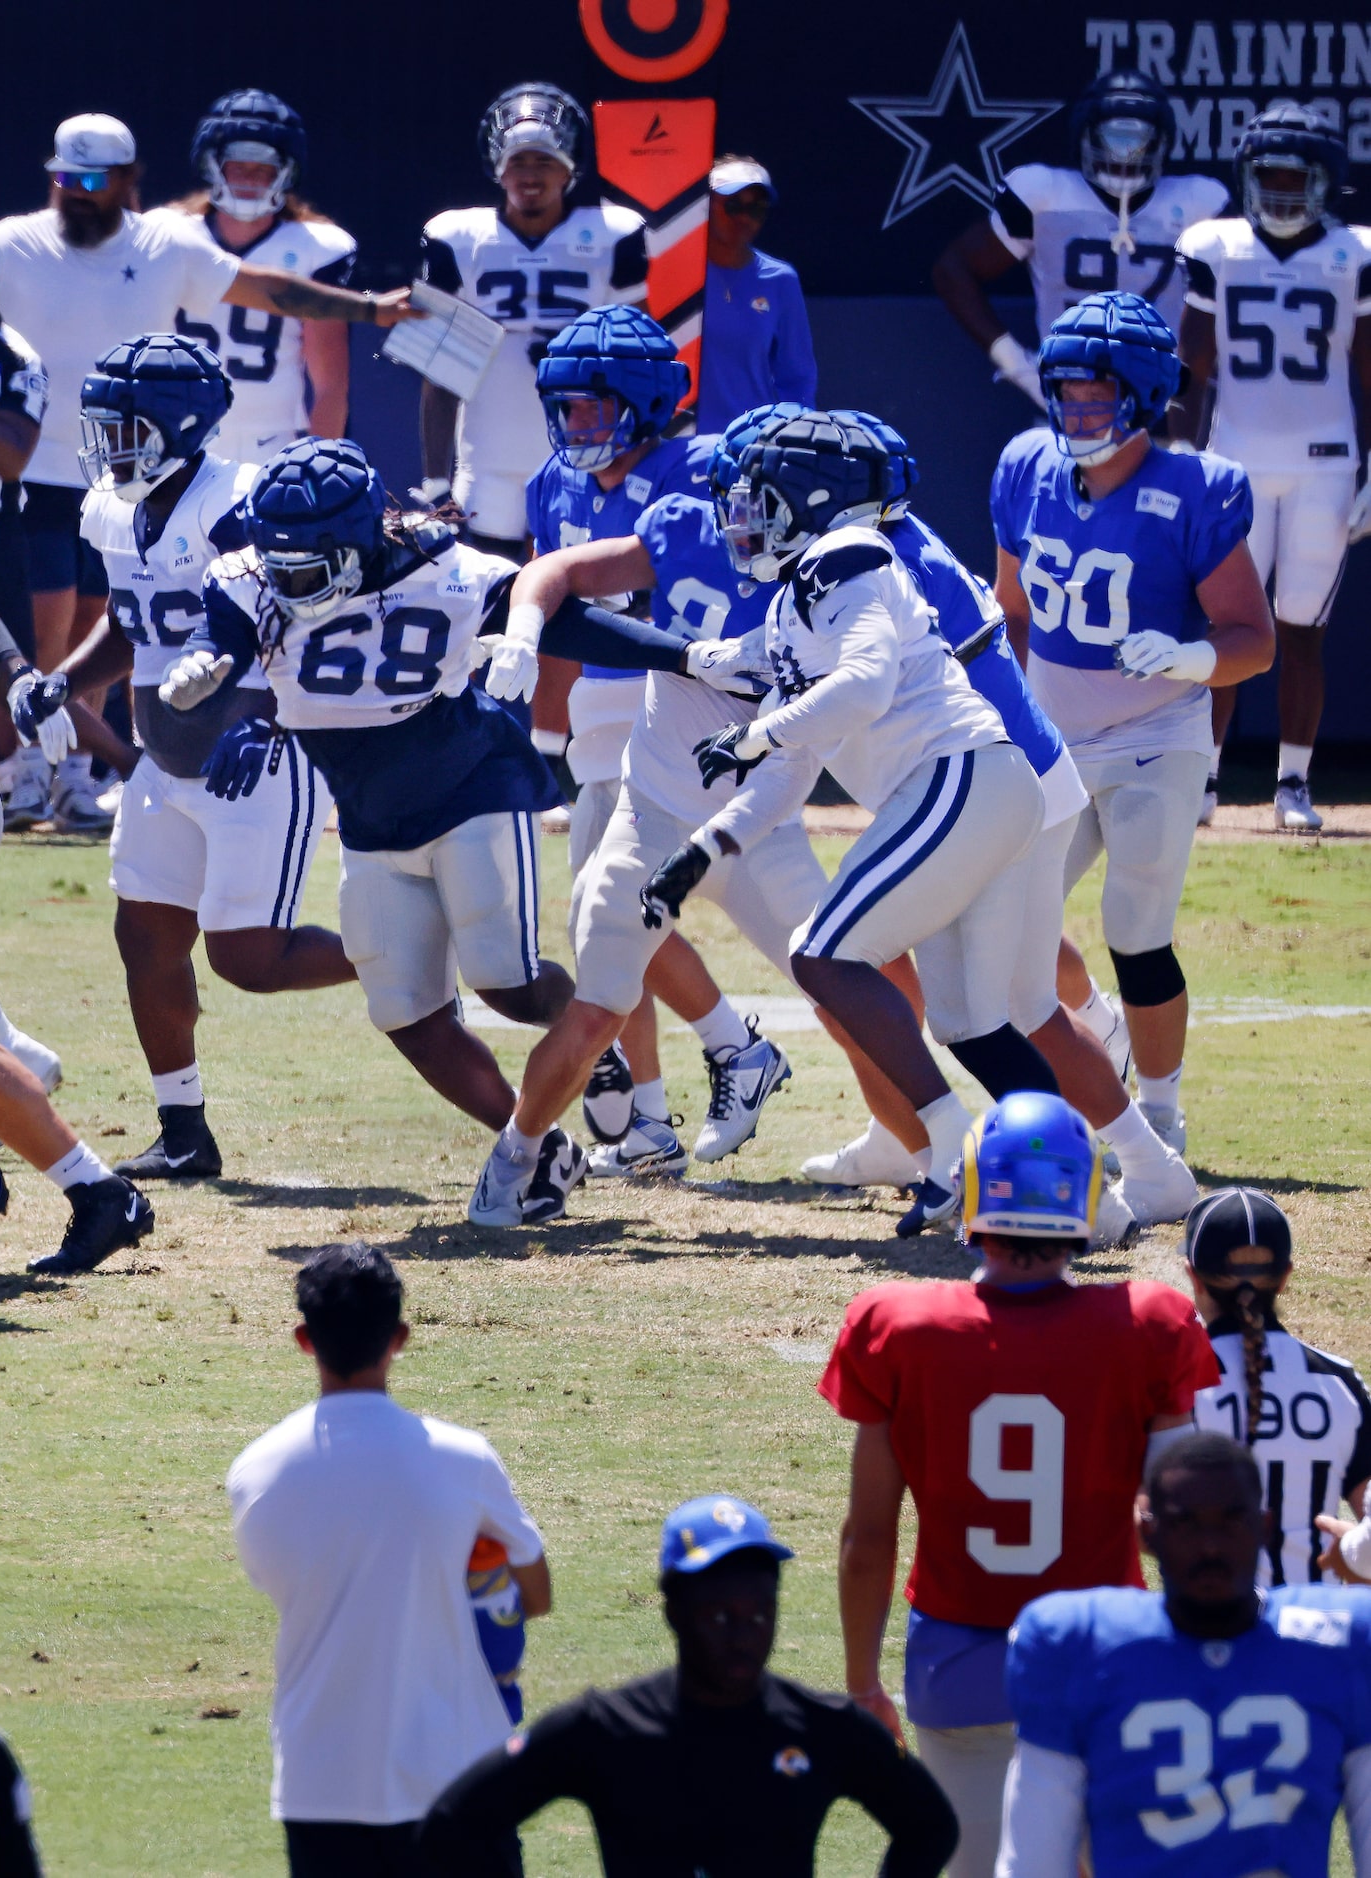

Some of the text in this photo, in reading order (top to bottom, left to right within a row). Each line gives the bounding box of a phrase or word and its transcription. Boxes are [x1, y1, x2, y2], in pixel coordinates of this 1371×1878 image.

[476, 270, 590, 320] 35
[1226, 285, 1336, 381] 53
[446, 584, 469, 594] AT&T
[1020, 533, 1134, 647] 60
[297, 606, 451, 696] 68
[966, 1393, 1066, 1576] 9
[1120, 1694, 1309, 1848] 32
